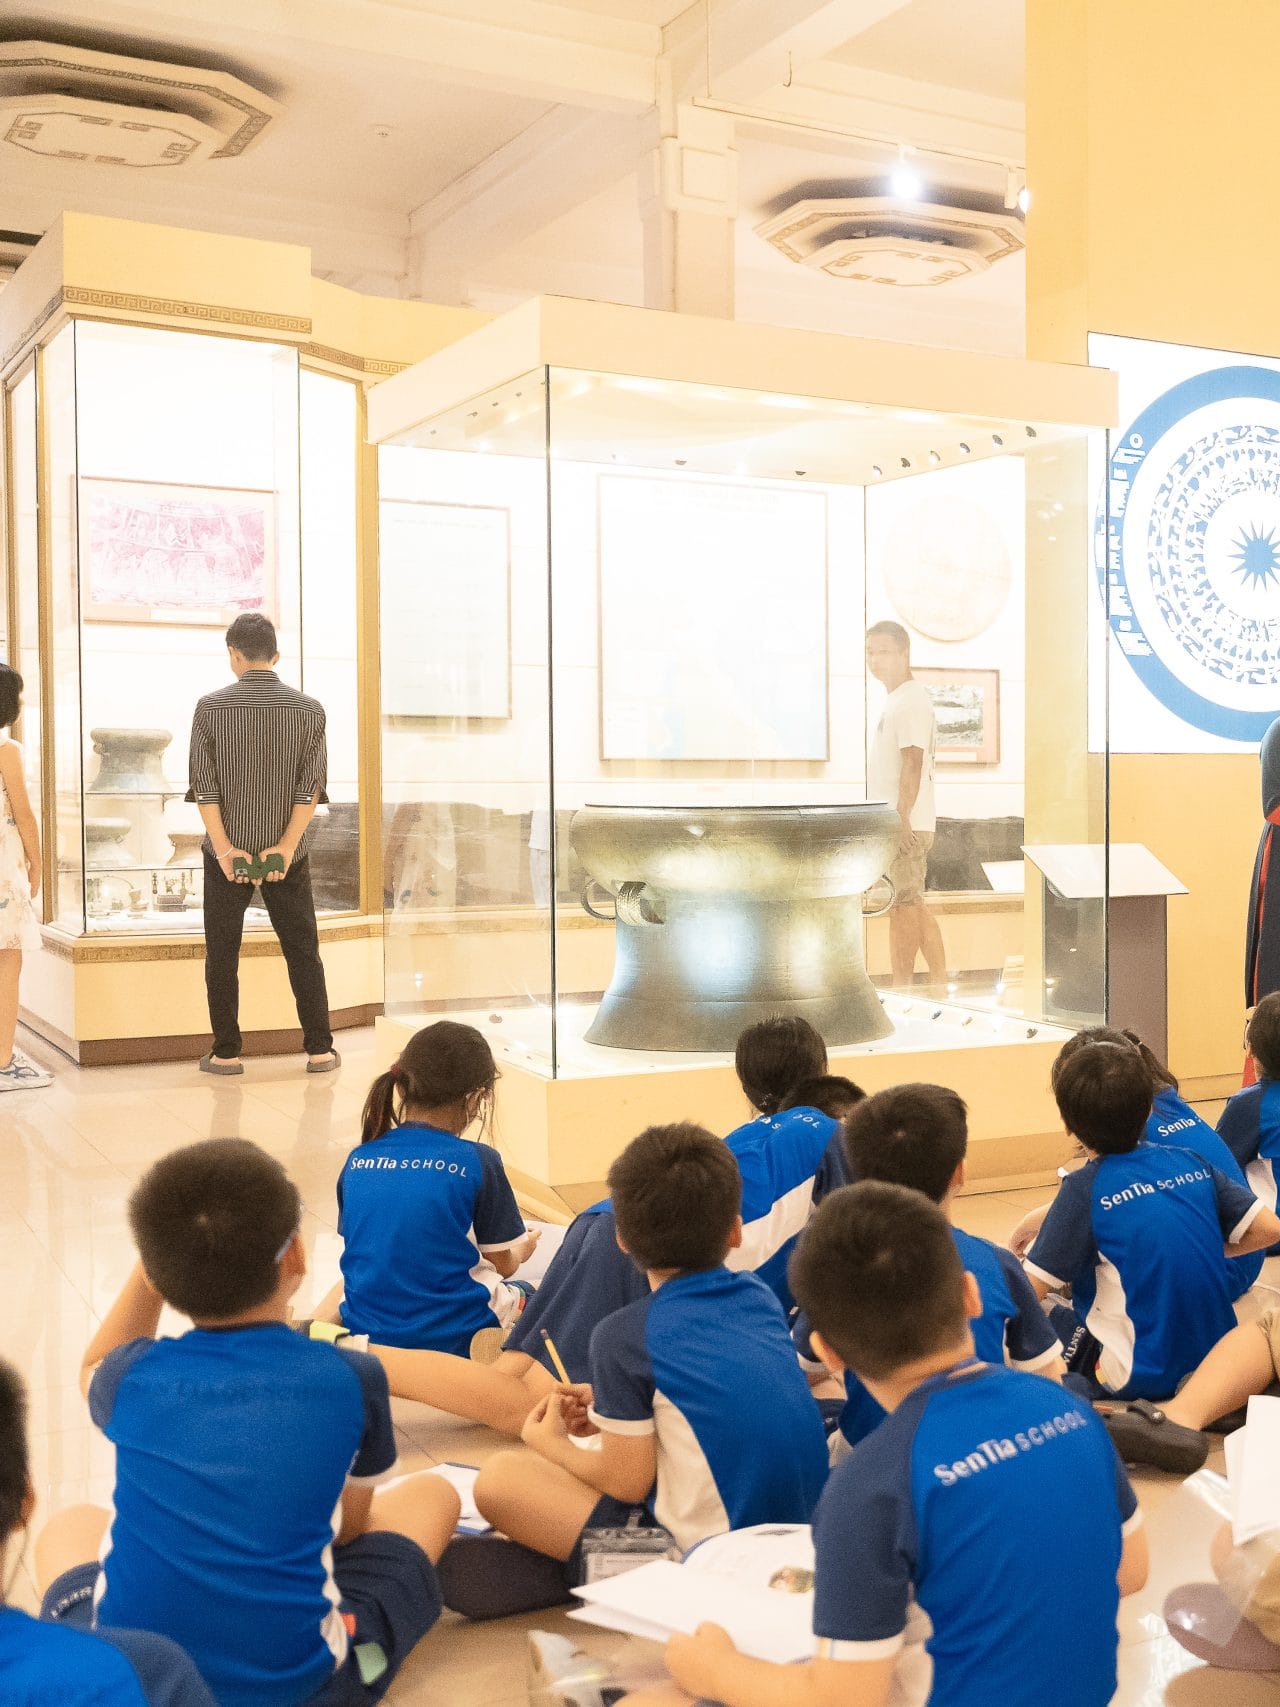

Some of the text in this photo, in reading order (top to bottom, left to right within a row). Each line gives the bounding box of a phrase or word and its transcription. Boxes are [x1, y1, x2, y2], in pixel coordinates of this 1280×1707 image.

[1157, 1118, 1196, 1137] SenTia
[350, 1156, 467, 1178] SenTia SCHOOL
[1100, 1168, 1212, 1211] SenTia SCHOOL
[933, 1409, 1088, 1487] SenTia SCHOOL
